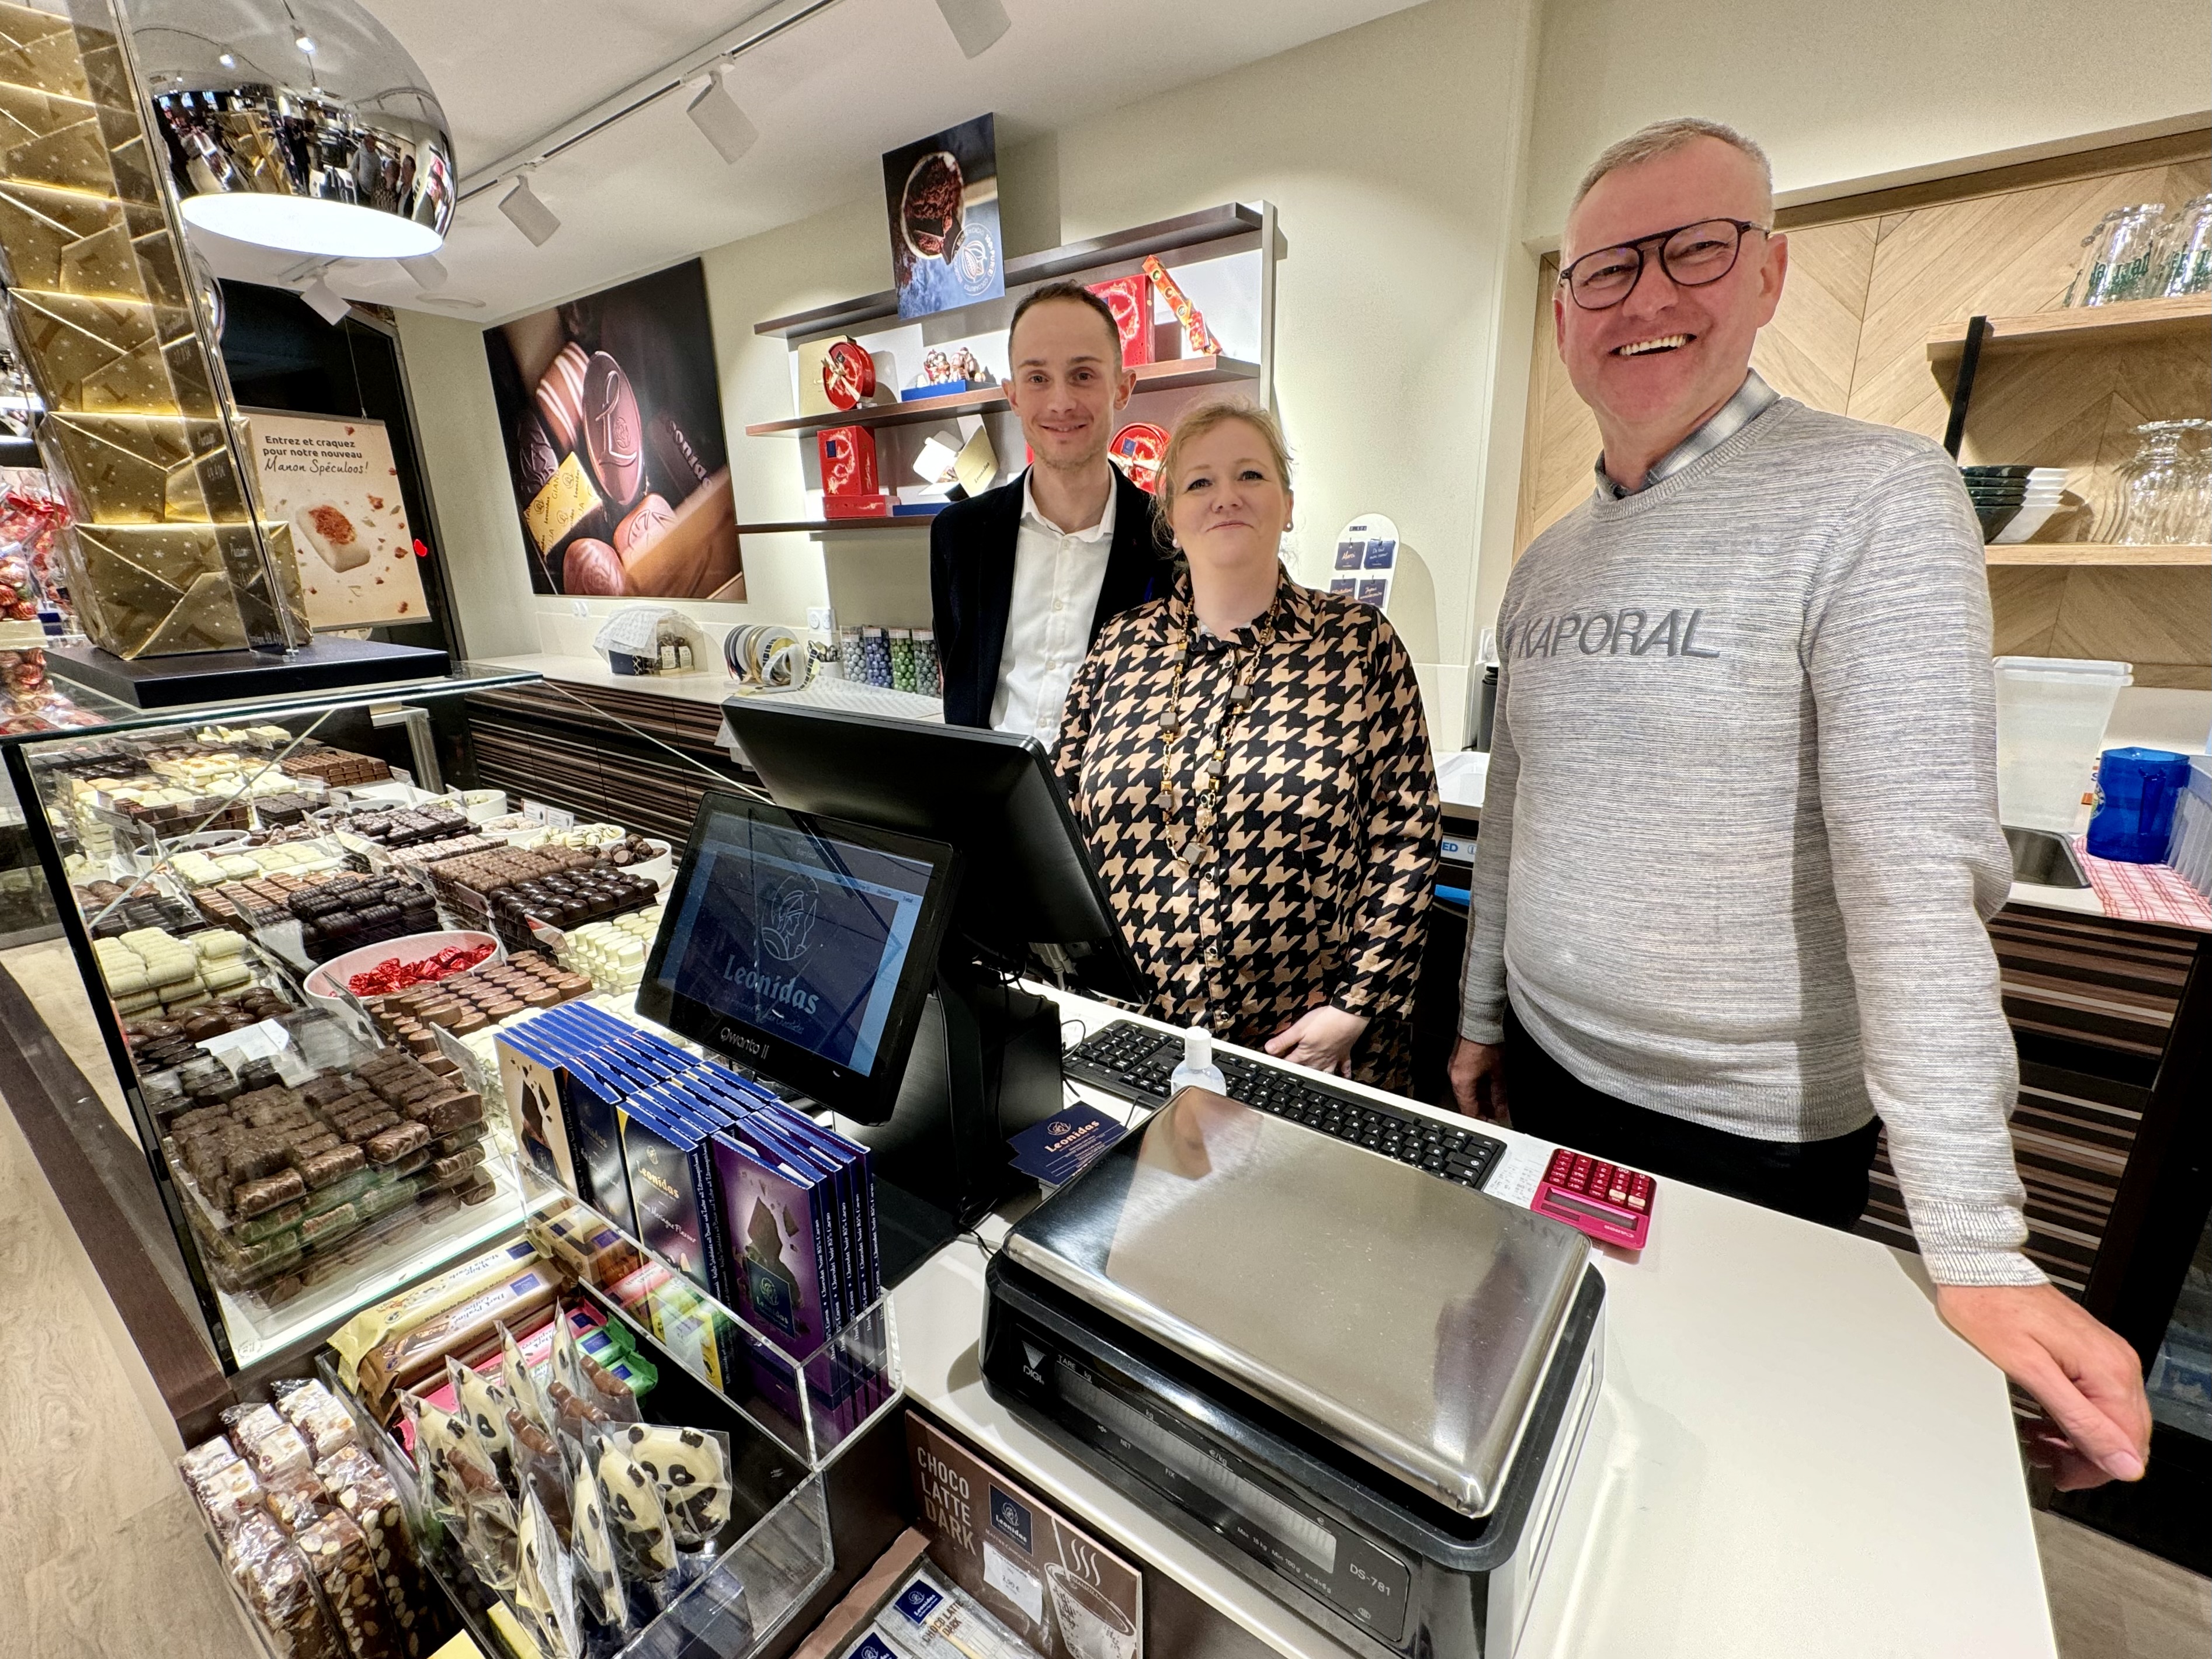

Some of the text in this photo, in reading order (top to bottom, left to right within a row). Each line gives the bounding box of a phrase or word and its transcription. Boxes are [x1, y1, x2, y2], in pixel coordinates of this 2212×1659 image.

[263, 448, 287, 456] pour
[265, 436, 300, 445] Entrez
[317, 440, 355, 448] craquez
[265, 456, 369, 476] Manon Spéculoos!
[1518, 609, 1720, 658] KAPORAL
[724, 954, 819, 1015] Leonidas
[720, 1026, 759, 1054] Qwanto
[1044, 1120, 1100, 1153] Leonidas
[1603, 1224, 1635, 1238] Canon
[1058, 1355, 1076, 1370] TARE
[1146, 1410, 1154, 1421] kg
[1120, 1439, 1131, 1449] NET
[918, 1447, 969, 1500] CHOCO
[921, 1471, 971, 1527] LATTE
[925, 1495, 976, 1556] DARK
[996, 1515, 1027, 1543] Leonidas
[1350, 1563, 1391, 1596] DS-781
[914, 1594, 936, 1616] Leonidas
[922, 1616, 944, 1643] CHOCO
[944, 1601, 964, 1620] LATTE
[943, 1618, 962, 1637] DARK
